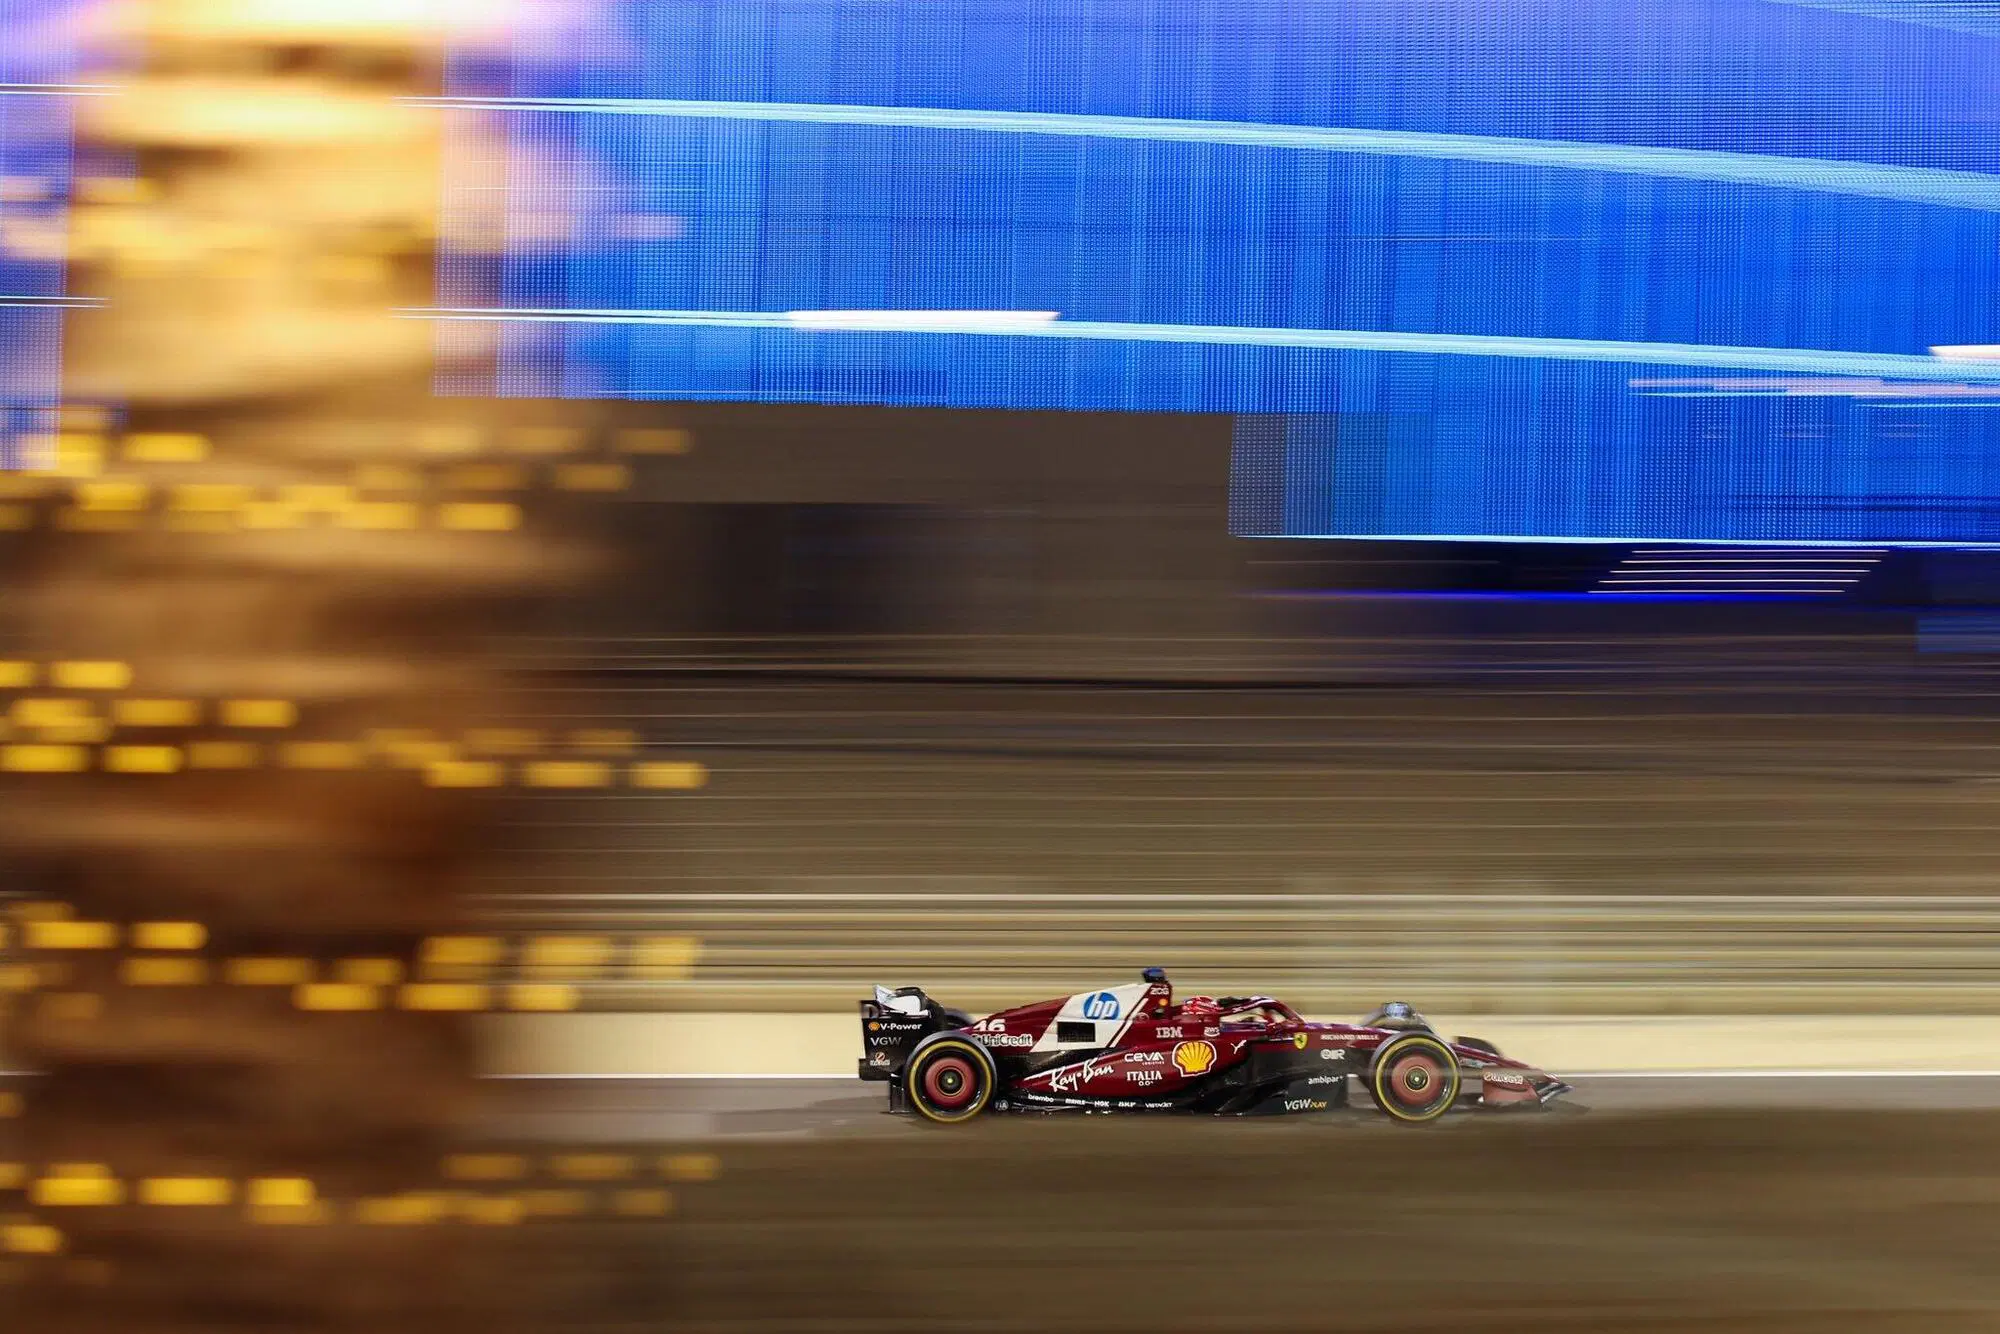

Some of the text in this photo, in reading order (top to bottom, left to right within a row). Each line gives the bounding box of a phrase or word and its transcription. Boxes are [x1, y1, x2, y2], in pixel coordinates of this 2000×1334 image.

[1085, 992, 1118, 1020] hp
[1156, 1026, 1183, 1038] IBM
[870, 1037, 902, 1046] VGW
[981, 1033, 1033, 1047] UniCredit
[1126, 1070, 1162, 1081] ITALIA
[1308, 1076, 1340, 1085] ambipar
[1027, 1094, 1054, 1103] brembo
